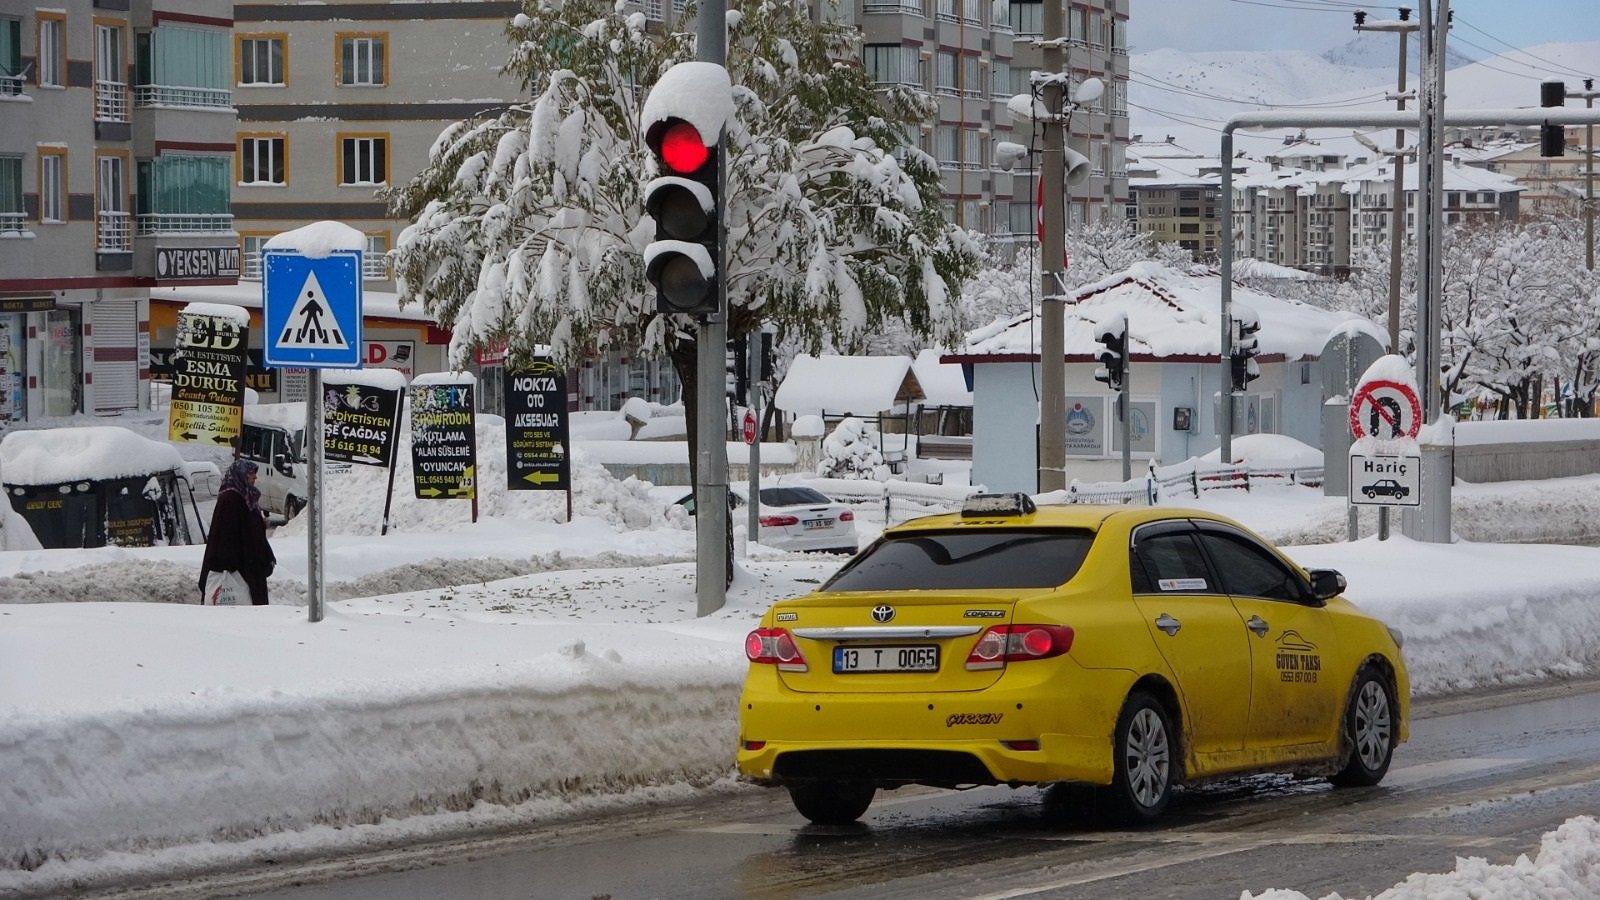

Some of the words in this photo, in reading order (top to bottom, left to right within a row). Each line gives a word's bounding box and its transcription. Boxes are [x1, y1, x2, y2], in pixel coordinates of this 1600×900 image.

[168, 249, 216, 276] YEKSEN
[186, 360, 231, 377] ESMA
[176, 374, 239, 393] DURUK
[513, 377, 557, 392] NOKTA
[174, 401, 194, 411] 0501
[198, 404, 213, 414] 105
[215, 406, 225, 414] 20
[229, 407, 239, 416] 10
[527, 394, 544, 408] OTO
[173, 419, 206, 431] Güzellik
[208, 423, 239, 434] Salonu
[336, 411, 391, 427] DİYETİSYEN
[413, 413, 471, 426] SHOWROOM
[514, 413, 559, 427] AKSESUAR
[342, 426, 387, 445] ÇAĞDAŞ
[338, 441, 355, 451] 616
[356, 444, 368, 453] 18
[370, 445, 381, 455] 94
[1364, 461, 1407, 476] Hariç
[844, 650, 859, 669] 13
[874, 650, 883, 668] T
[898, 649, 935, 668] 0065
